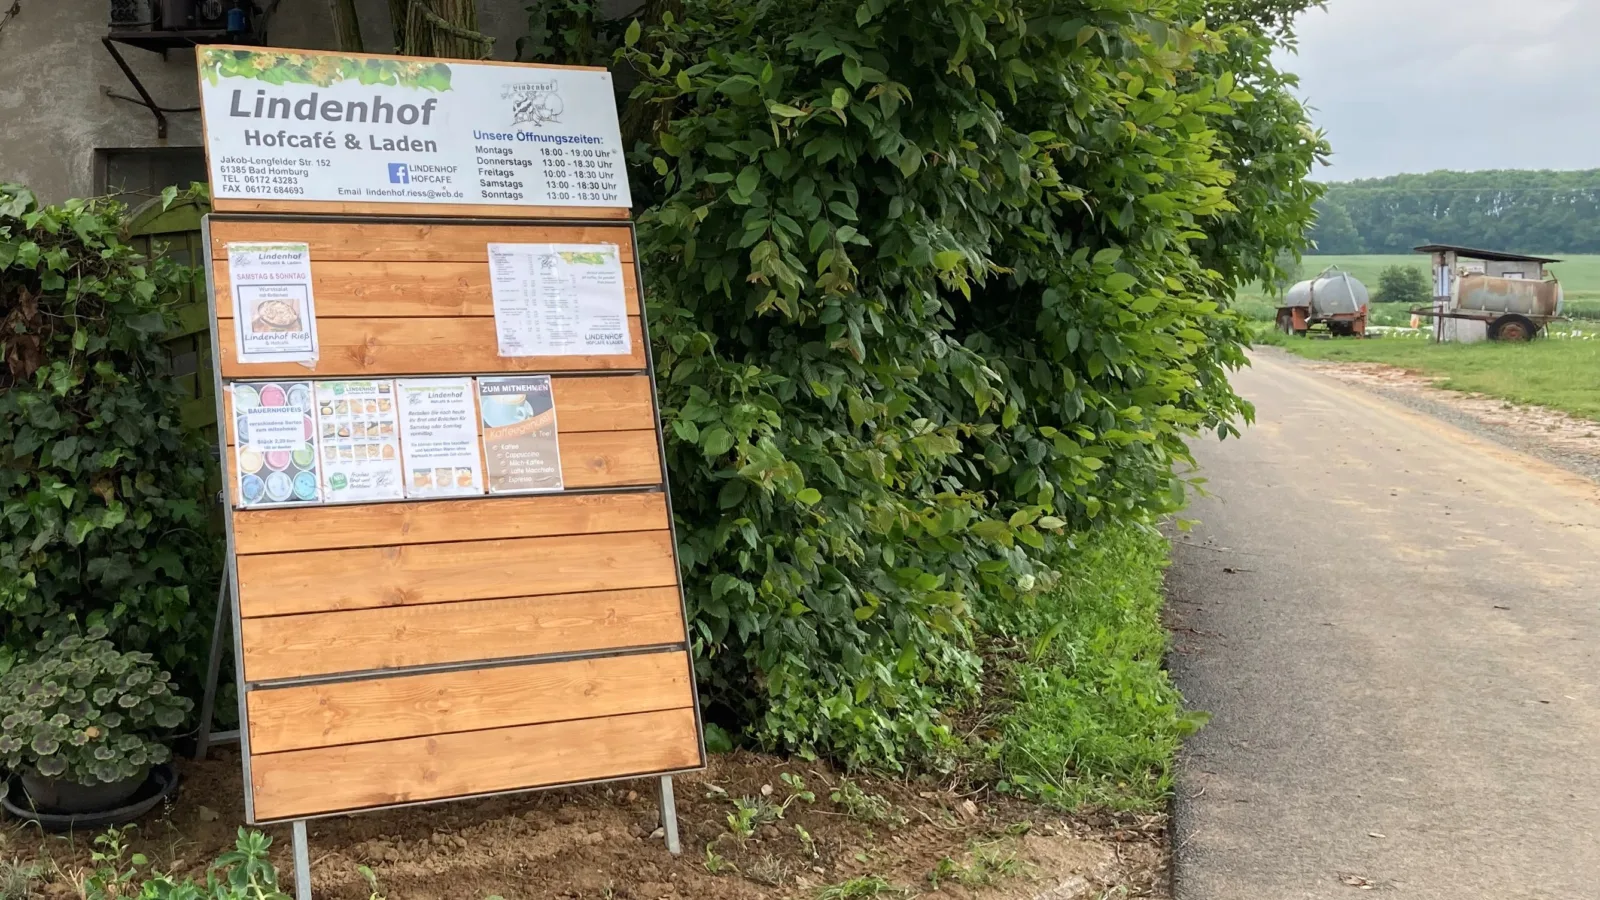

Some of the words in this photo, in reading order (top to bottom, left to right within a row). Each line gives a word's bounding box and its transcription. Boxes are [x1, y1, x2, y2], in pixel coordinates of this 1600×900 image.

[229, 89, 438, 126] Lindenhof
[244, 129, 336, 149] Hofcafé
[344, 133, 363, 150] &
[369, 134, 438, 153] Laden
[473, 129, 514, 141] Unsere
[516, 129, 604, 145] Öffnungszeiten:
[475, 145, 514, 155] Montags
[540, 148, 563, 157] 18:00
[570, 149, 593, 157] 19:00
[595, 149, 610, 158] Uhr
[220, 156, 297, 168] Jakob-Lengfelder
[299, 158, 313, 167] Str.
[316, 158, 331, 167] 152
[476, 157, 533, 168] Donnerstags
[542, 159, 566, 167] 13:00
[597, 160, 613, 169] Uhr
[220, 165, 247, 174] 61385
[249, 166, 266, 175] Bad
[268, 167, 309, 178] Homburg
[409, 165, 458, 173] LINDENHOF
[478, 168, 514, 178] Freitags
[222, 175, 239, 183] TEL
[244, 175, 270, 184] 06172
[272, 176, 298, 185] 43283
[411, 175, 452, 184] HOFCAFE
[543, 170, 566, 178] 10:00
[574, 171, 597, 179] 18:30
[599, 171, 614, 180] Uhr
[480, 179, 524, 189] Samstags
[546, 181, 569, 190] 13:00
[577, 182, 599, 190] 18:30
[601, 182, 617, 191] Uhr
[222, 185, 241, 193] FAX
[245, 185, 272, 194] 06172
[273, 186, 304, 195] 684693
[338, 187, 362, 196] Email
[366, 188, 464, 199] lindenhof.riess@web.de
[481, 190, 524, 200] Sonntags
[547, 192, 570, 200] 13:00
[577, 193, 600, 201] 18:30
[602, 193, 618, 201] Uhr
[236, 273, 268, 281] SAMSTAG
[275, 272, 306, 280] SONNTAG
[245, 332, 289, 341] Lindenhof
[584, 333, 624, 341] LINDENHOF
[482, 385, 500, 393] ZUM
[502, 384, 549, 393] MITNEHMEN
